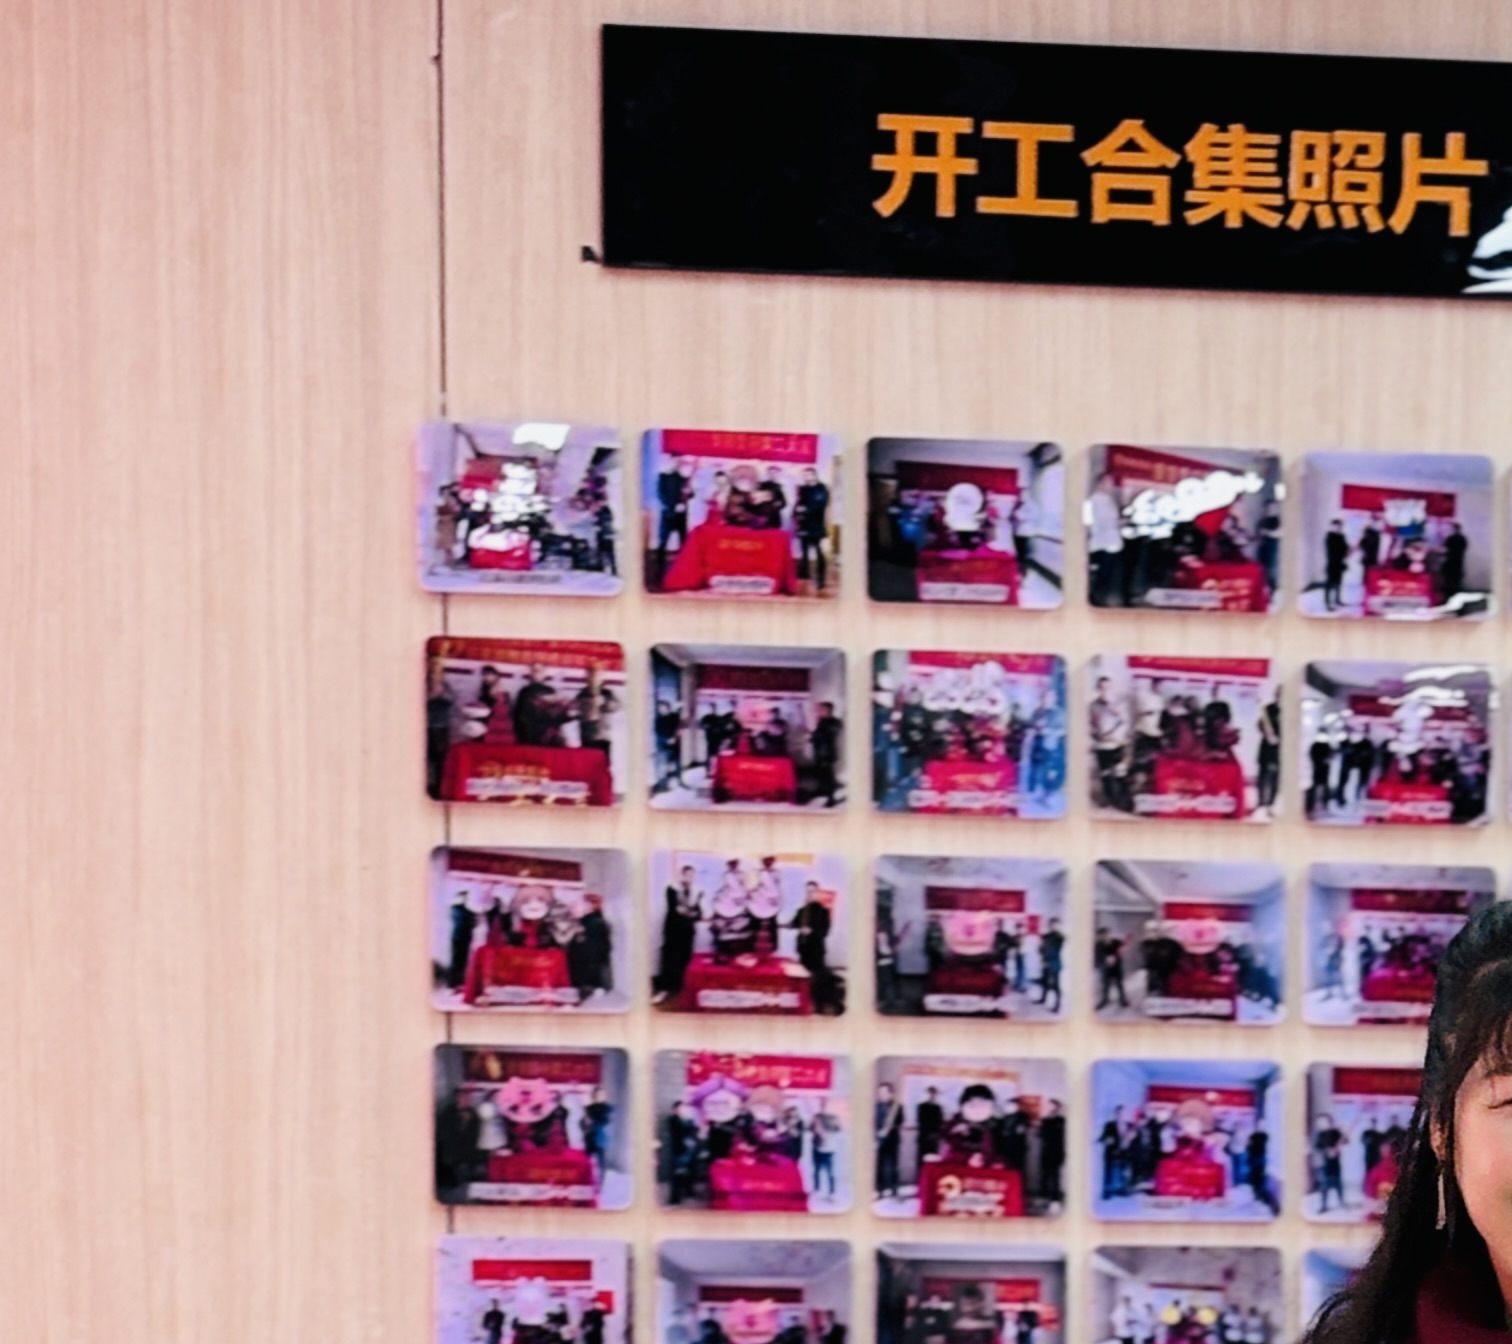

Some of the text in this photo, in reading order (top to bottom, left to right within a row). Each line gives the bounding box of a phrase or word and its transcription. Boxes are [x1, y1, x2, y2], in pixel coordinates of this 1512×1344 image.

[870, 111, 1490, 238] 开工合集照片
